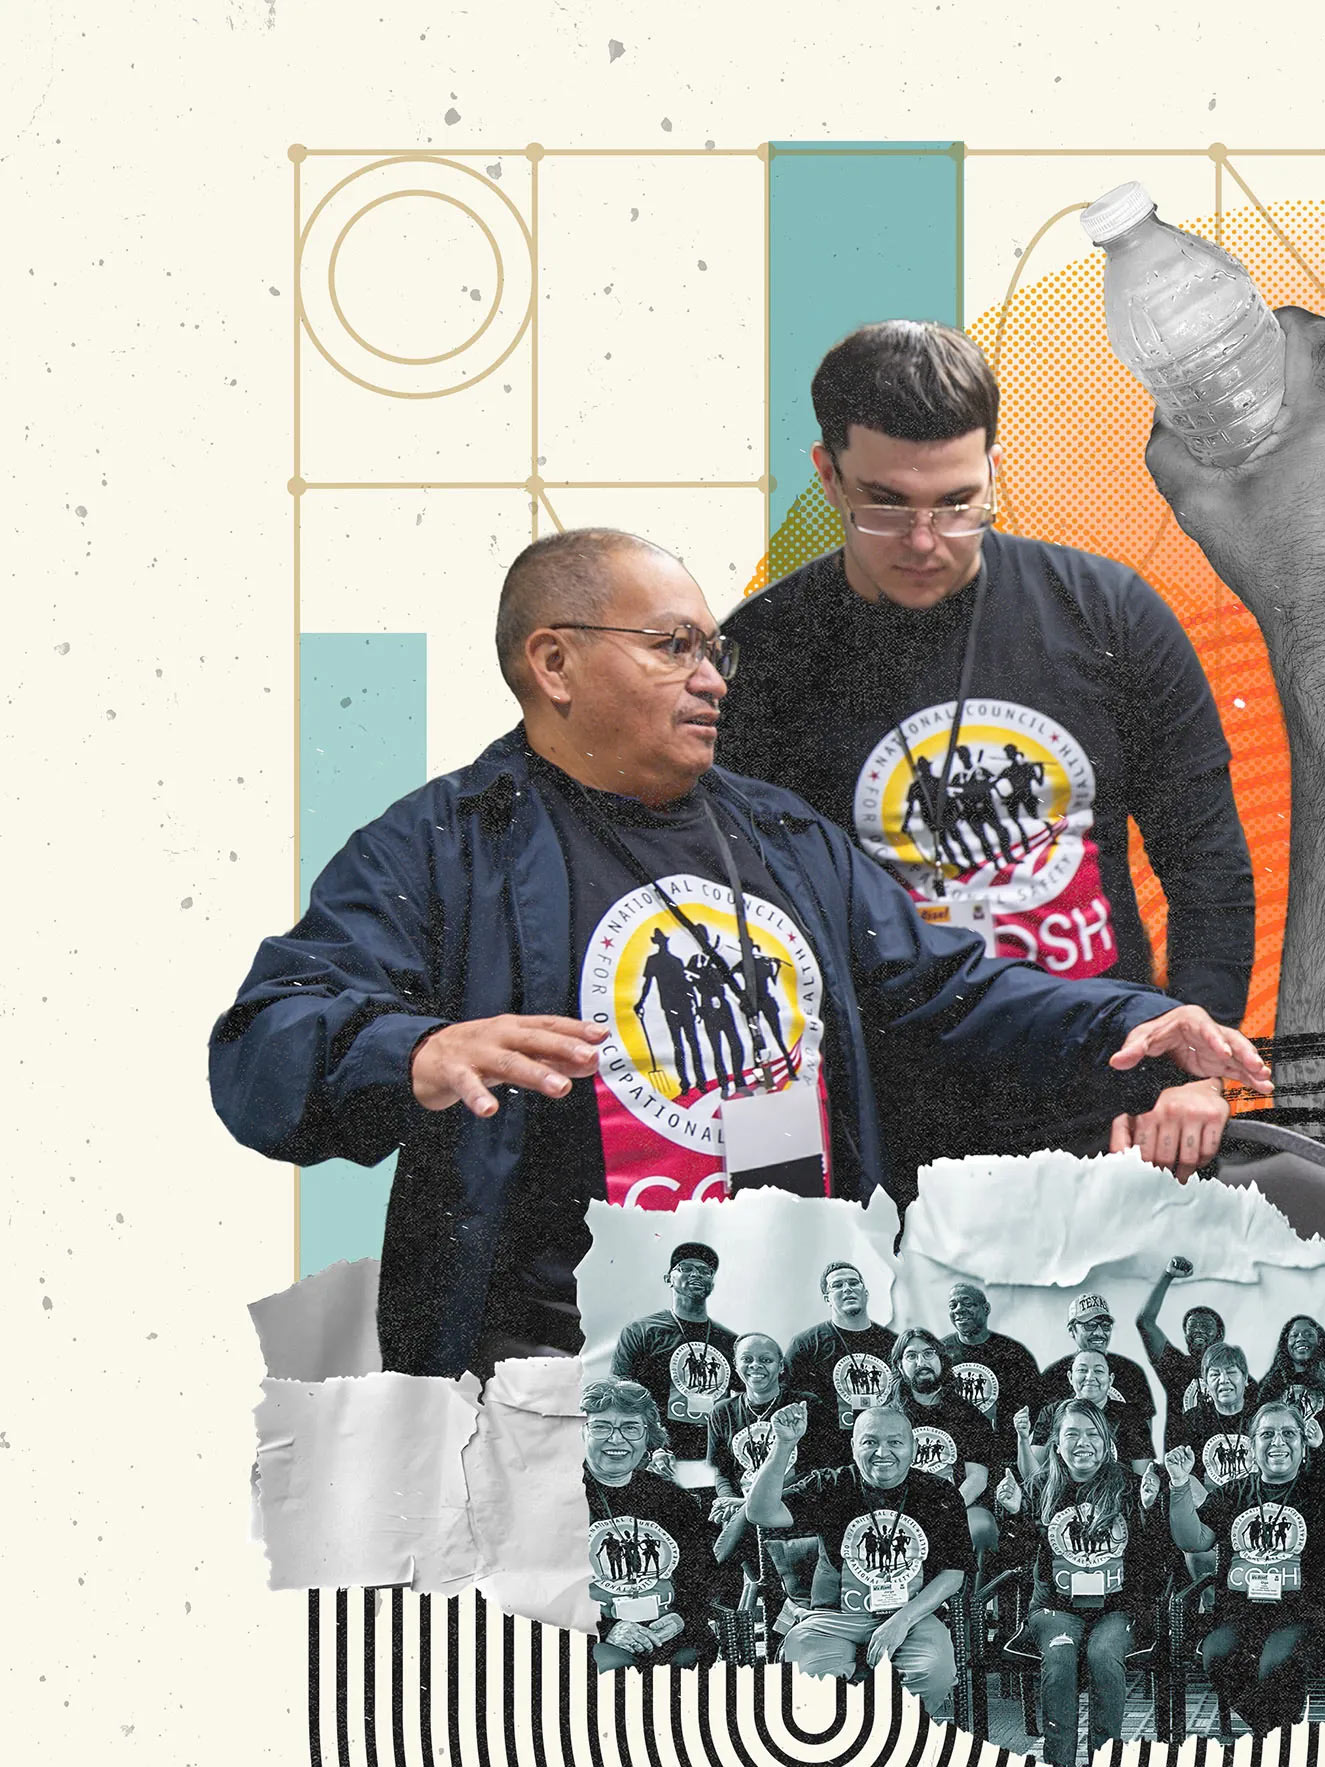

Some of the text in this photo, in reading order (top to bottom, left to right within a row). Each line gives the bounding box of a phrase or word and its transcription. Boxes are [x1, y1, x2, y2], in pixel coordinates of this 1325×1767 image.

[875, 704, 1046, 767] NATONAL COUNCIL
[862, 786, 880, 823] FOR
[608, 880, 784, 934] NATIOAL COUCIL
[591, 952, 612, 995] FOR
[795, 948, 819, 1032] HEALTH
[593, 1012, 726, 1145] OCUPATIONAL
[1055, 1568, 1121, 1590] CH
